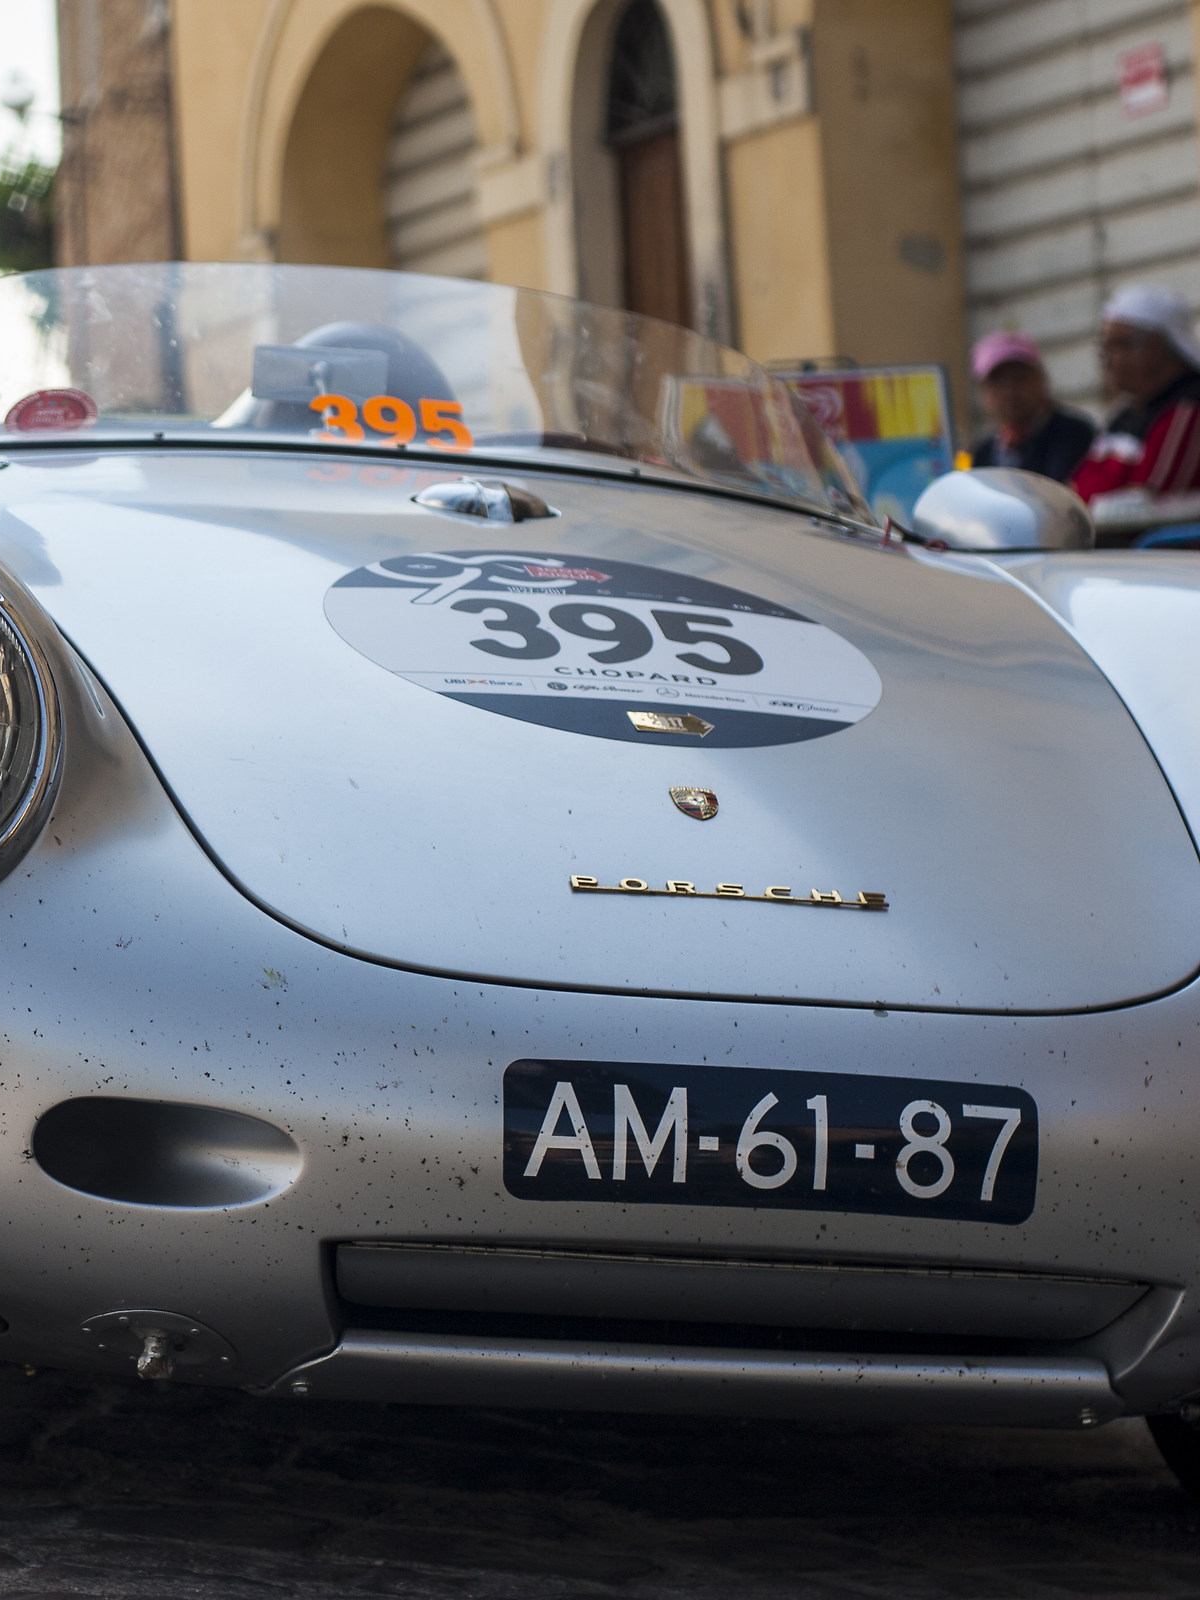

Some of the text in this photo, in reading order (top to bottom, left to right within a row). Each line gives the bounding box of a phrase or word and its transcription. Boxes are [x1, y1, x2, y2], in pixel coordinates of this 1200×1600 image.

[309, 394, 474, 454] 395
[450, 598, 764, 676] 395
[444, 677, 523, 688] UBI Banca
[554, 665, 718, 687] CHOPARD
[568, 874, 888, 908] PORSCHE
[522, 1080, 1022, 1202] AM-61-87
